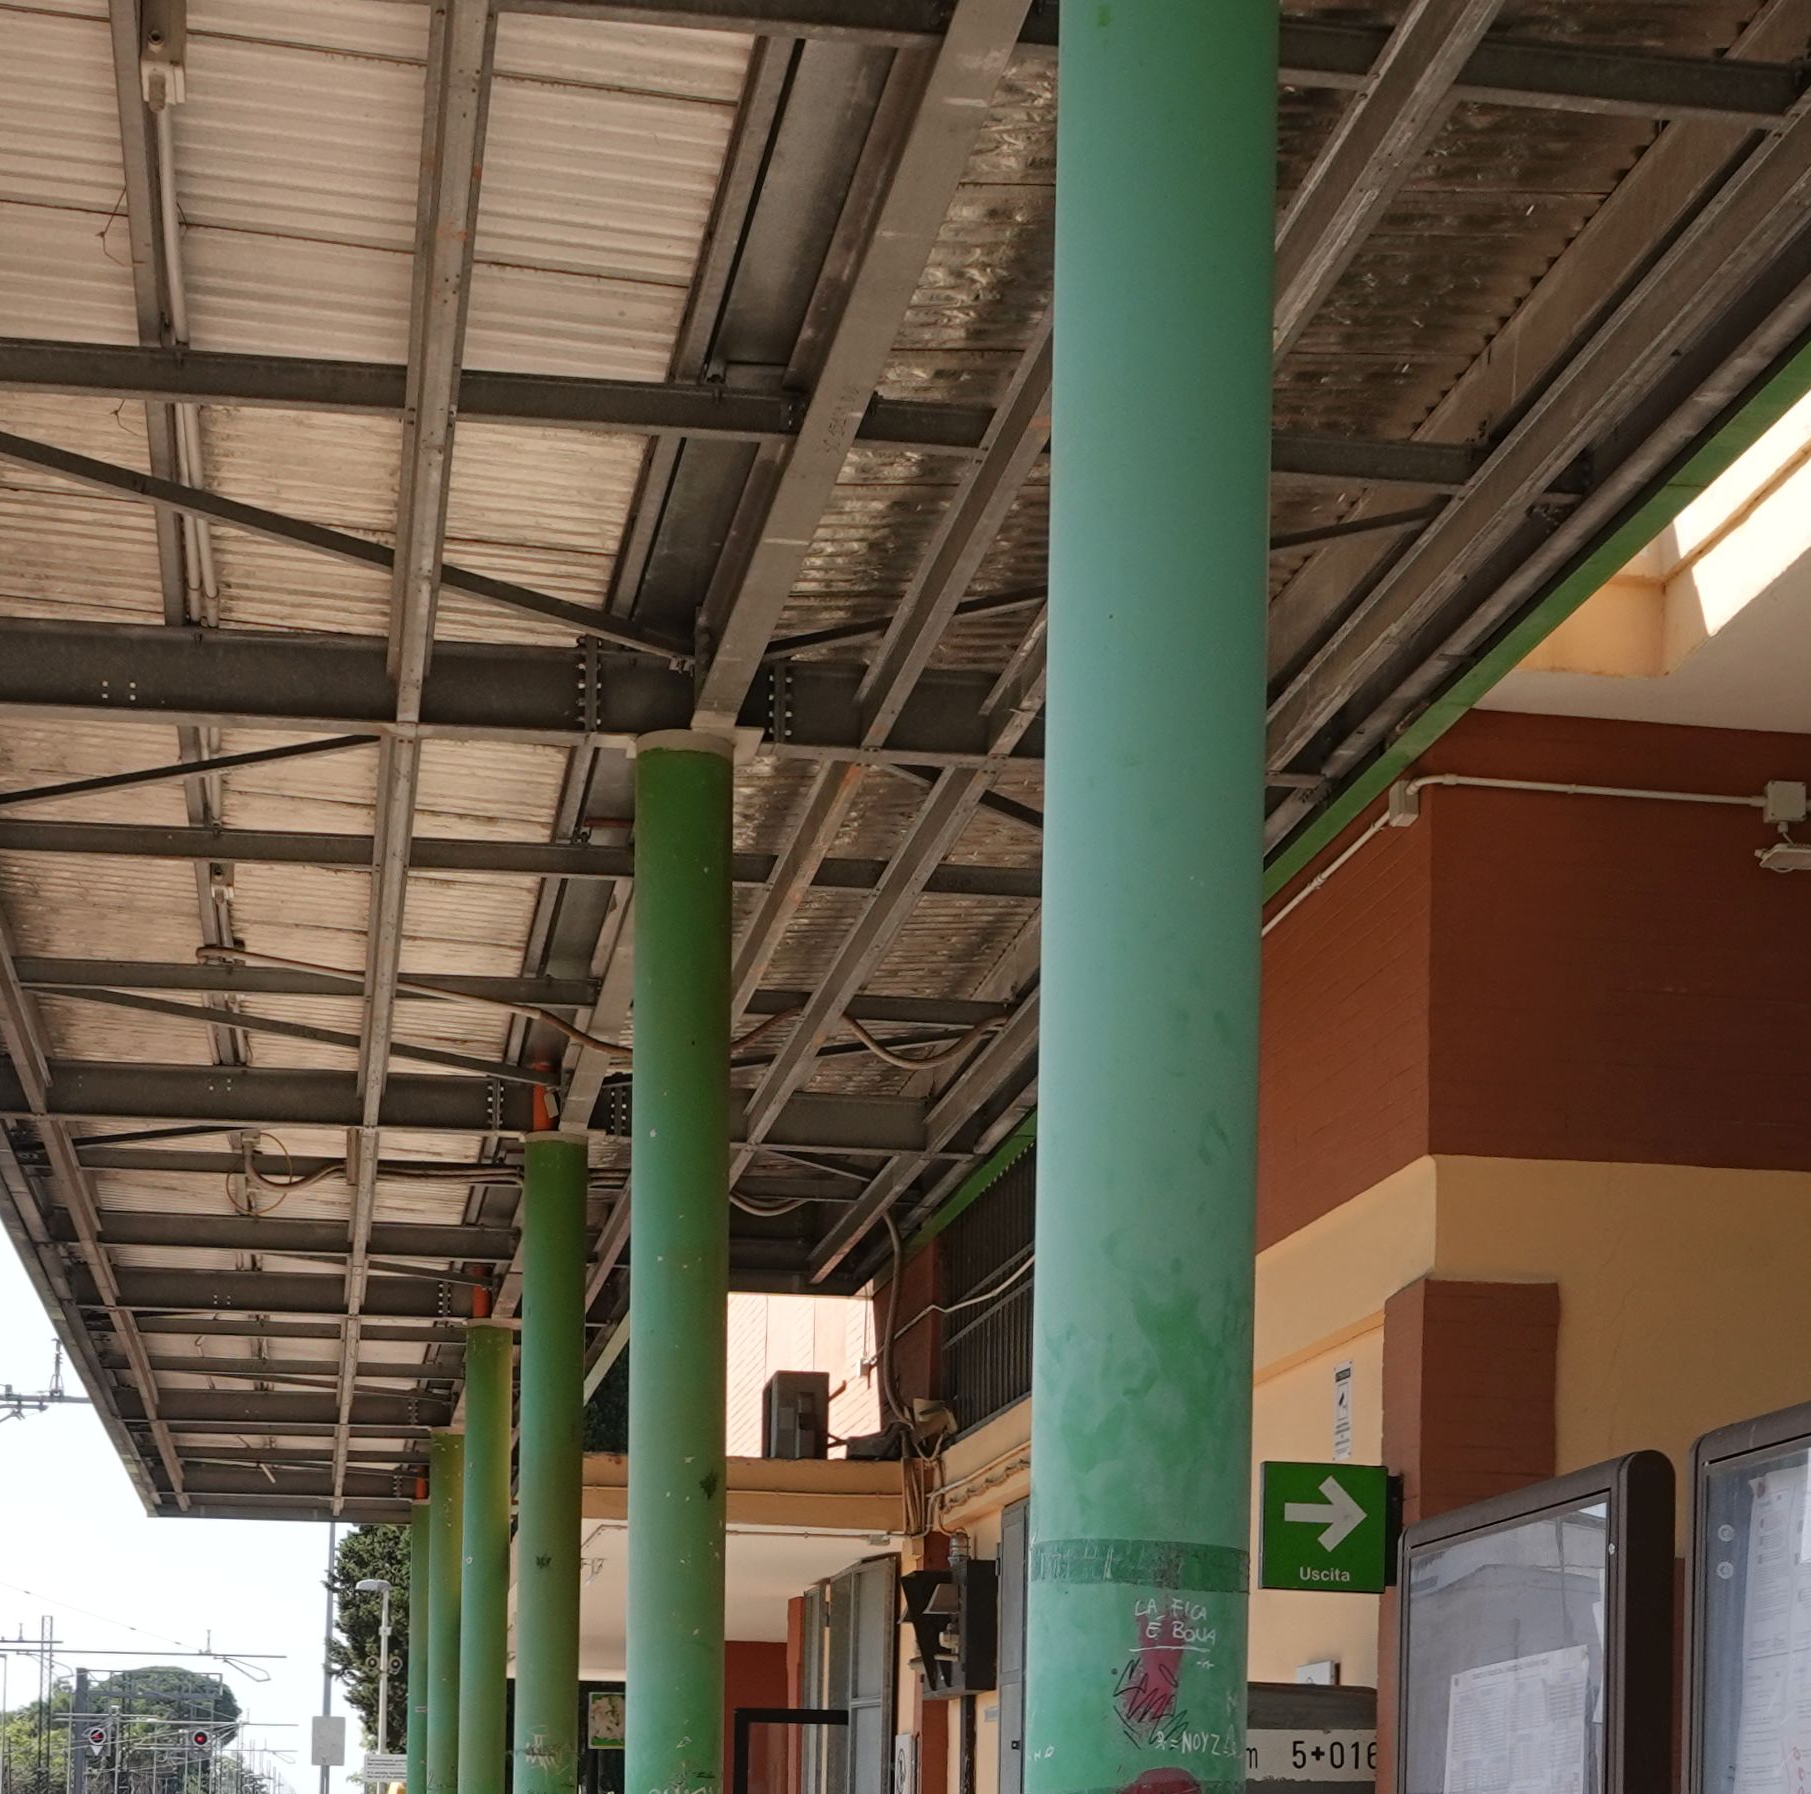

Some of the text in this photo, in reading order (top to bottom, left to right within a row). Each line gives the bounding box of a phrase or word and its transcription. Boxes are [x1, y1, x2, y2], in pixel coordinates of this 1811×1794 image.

[1299, 1566, 1351, 1584] Uscita
[1134, 1597, 1207, 1620] LA FICA
